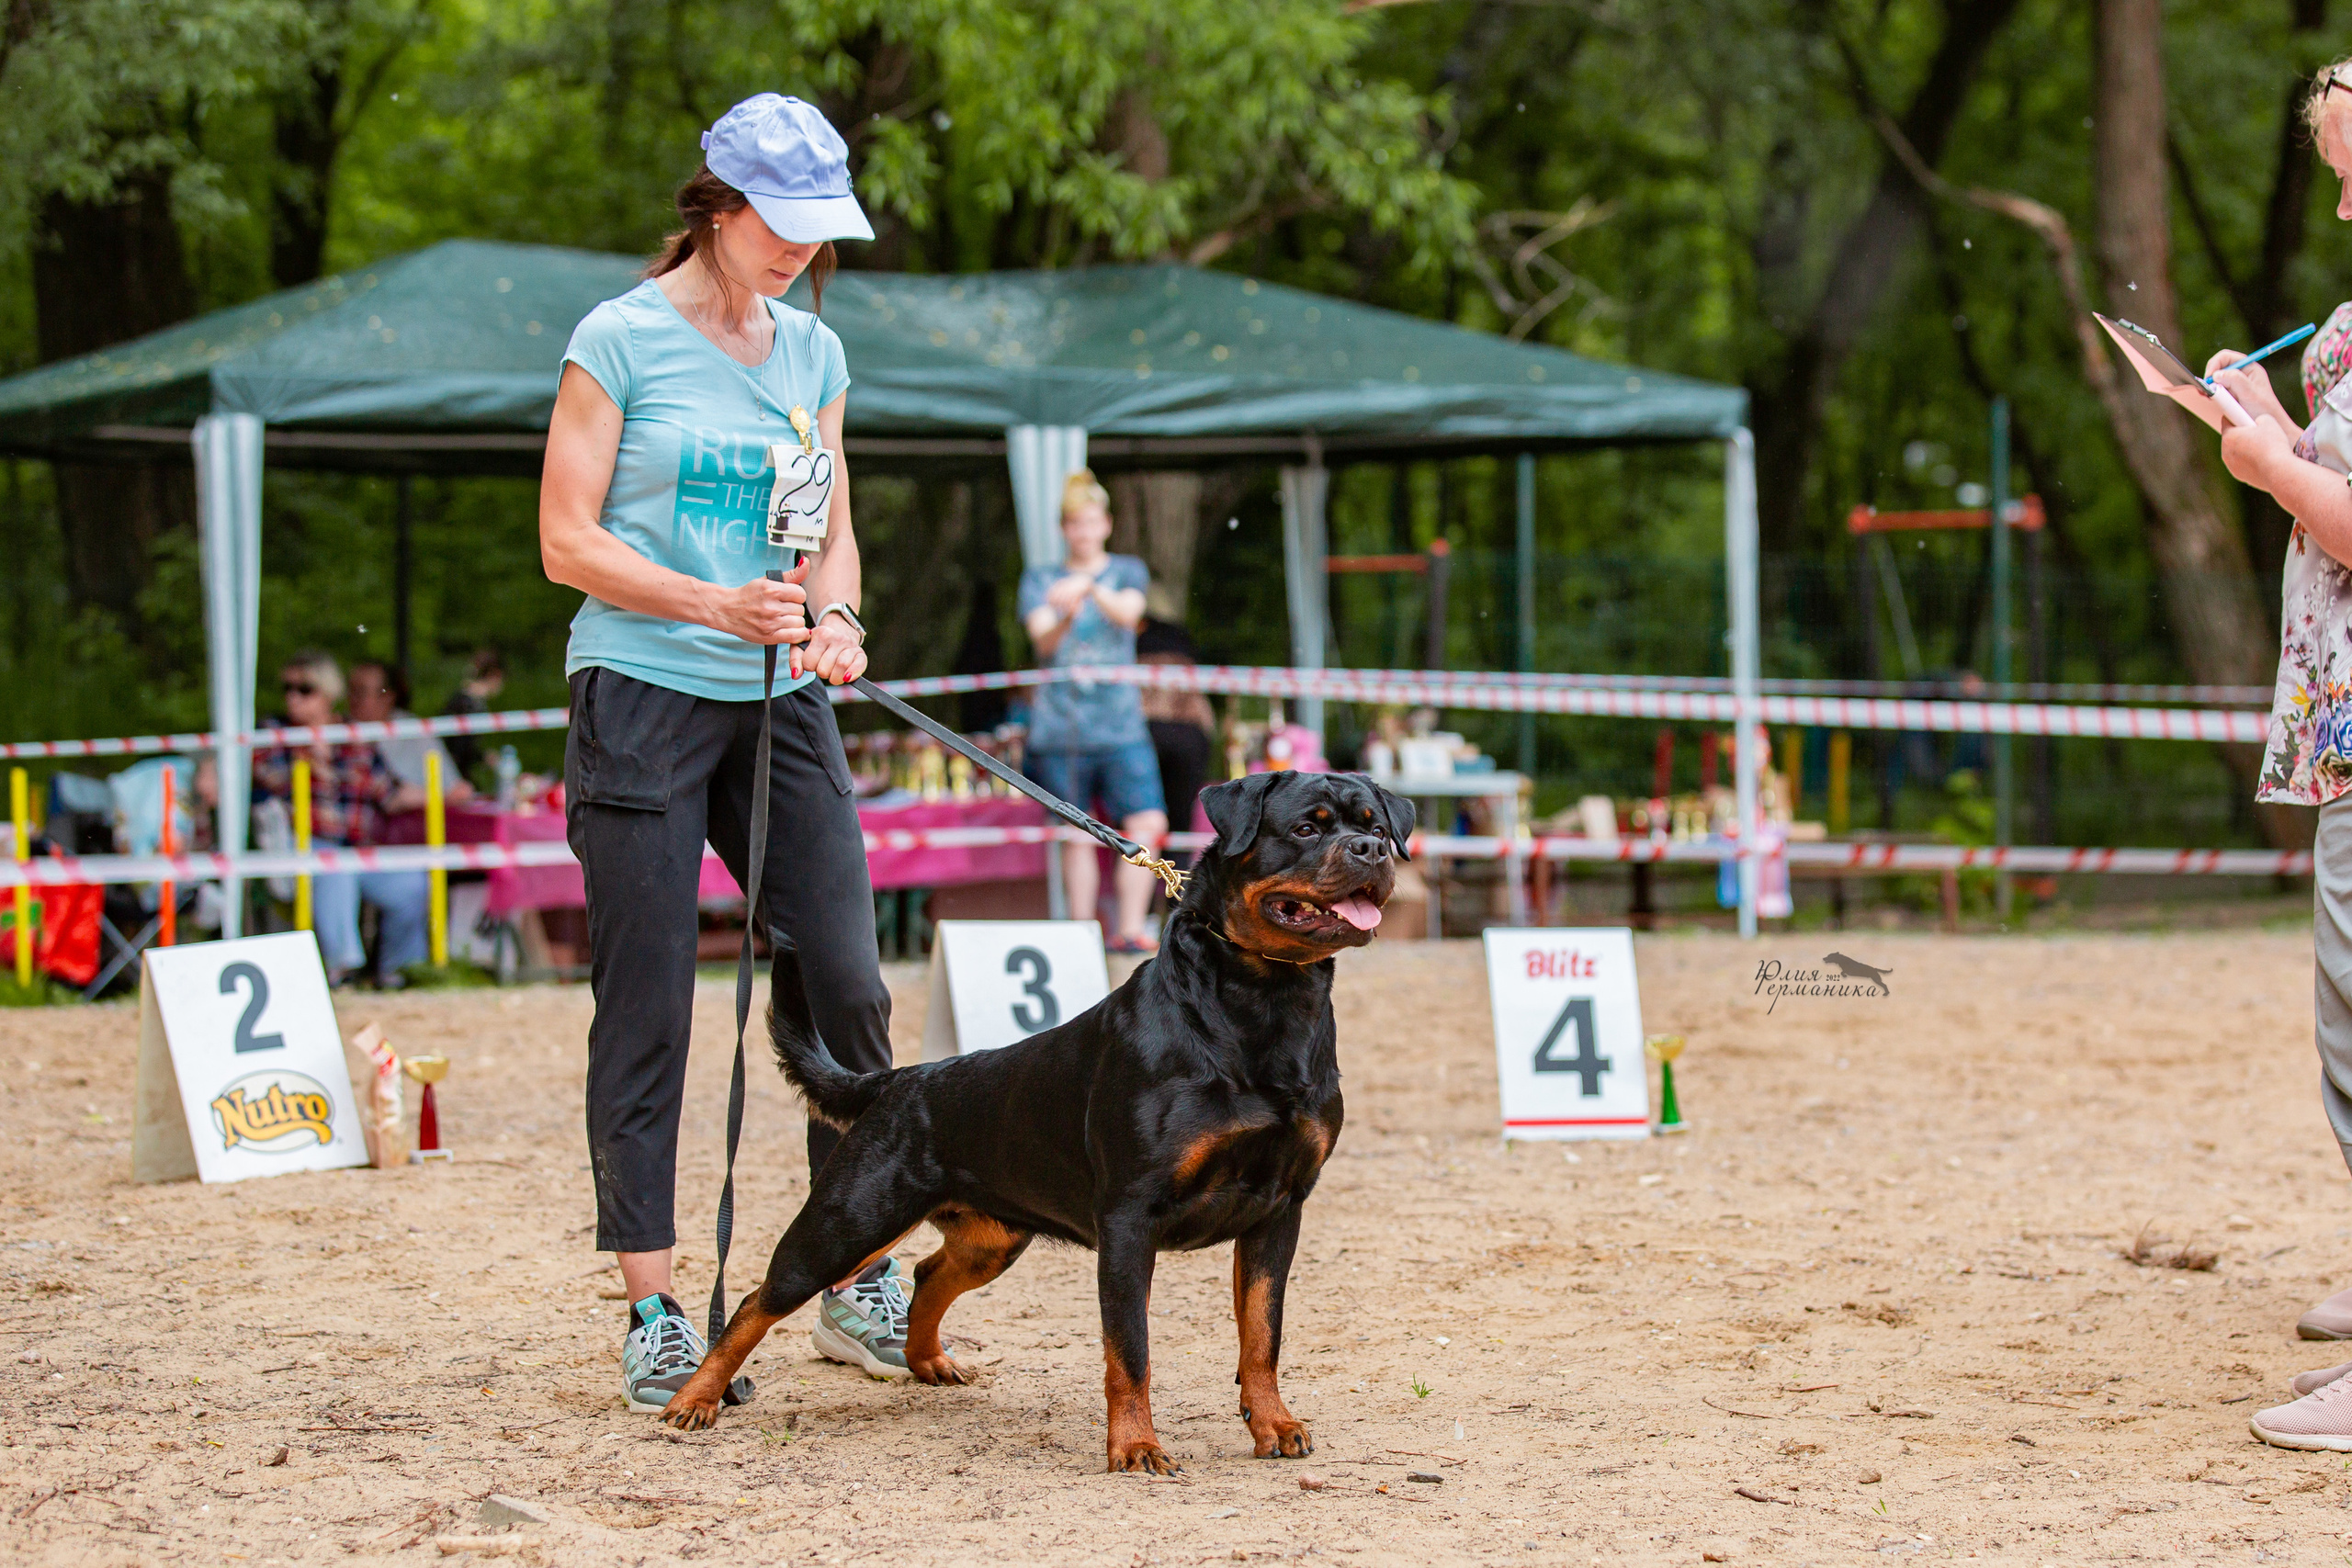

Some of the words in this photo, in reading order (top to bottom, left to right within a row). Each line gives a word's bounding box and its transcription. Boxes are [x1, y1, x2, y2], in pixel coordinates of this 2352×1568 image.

[693, 425, 786, 479] RU
[778, 453, 831, 516] 29
[677, 512, 785, 558] NIGH
[1006, 947, 1059, 1033] 3
[1524, 949, 1597, 978] Blitz
[220, 961, 285, 1054] 2
[1532, 998, 1611, 1098] 4
[210, 1082, 334, 1150] Nutro
